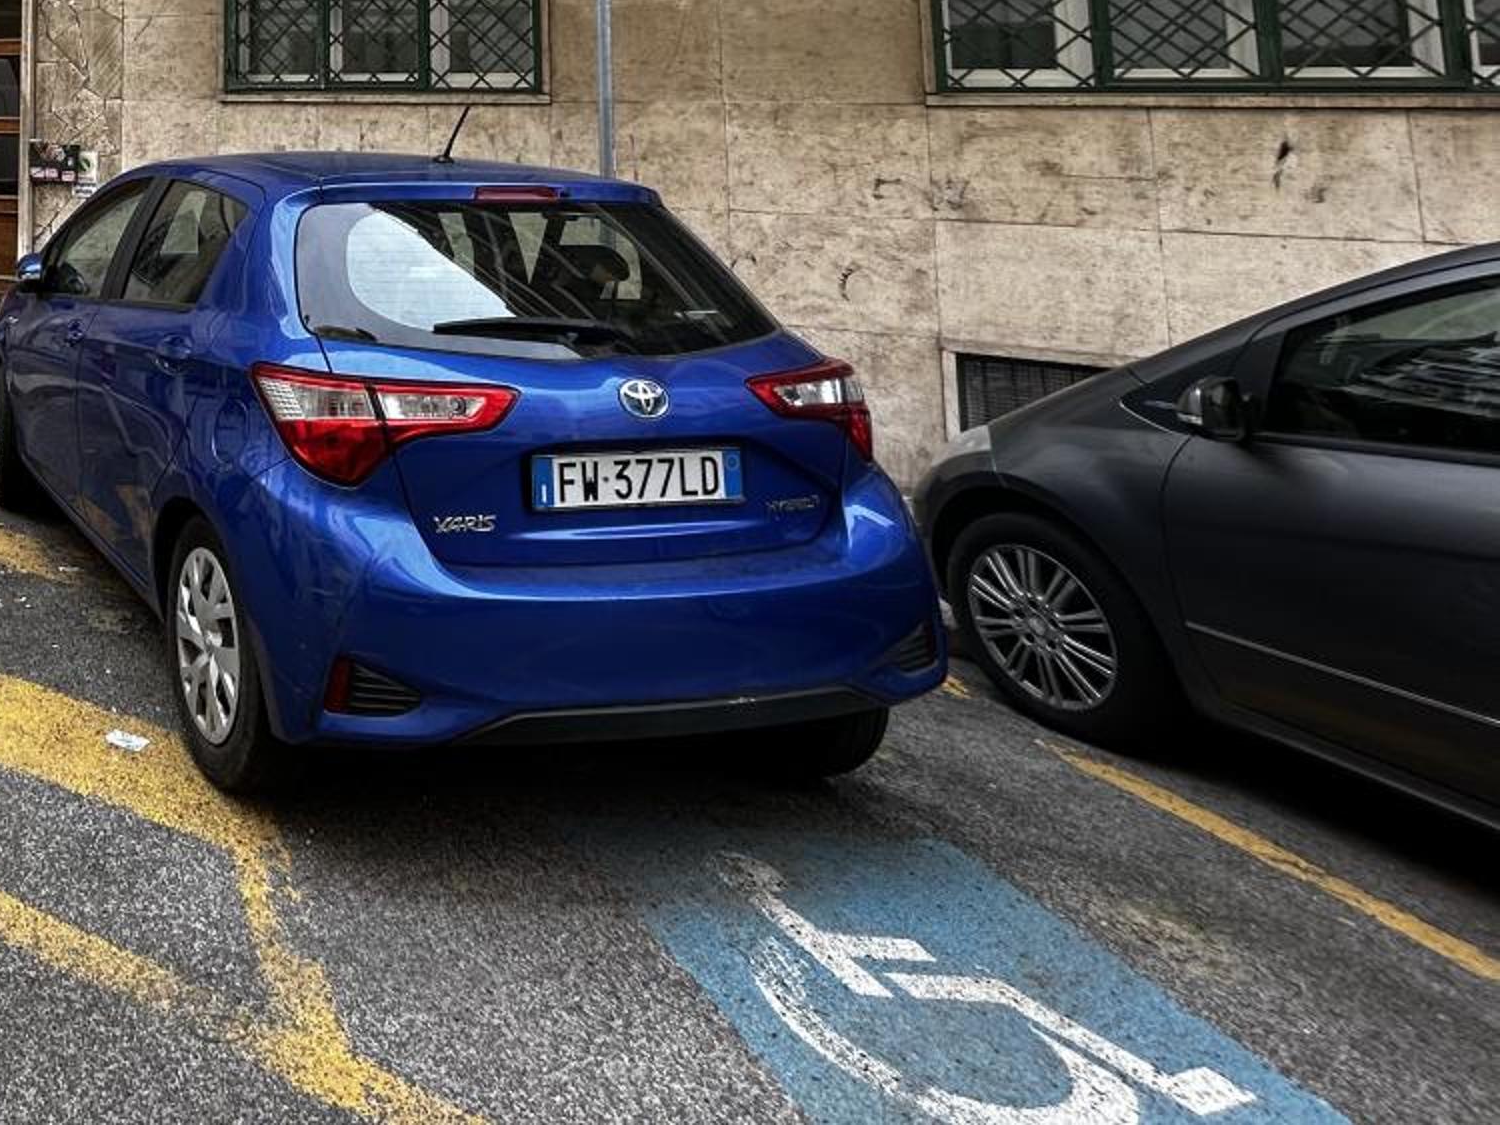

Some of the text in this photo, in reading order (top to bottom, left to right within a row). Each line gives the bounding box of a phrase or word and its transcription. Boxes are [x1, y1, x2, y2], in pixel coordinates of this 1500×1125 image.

[558, 460, 599, 503] FW
[613, 456, 720, 500] 377LD
[433, 514, 497, 534] YARIS
